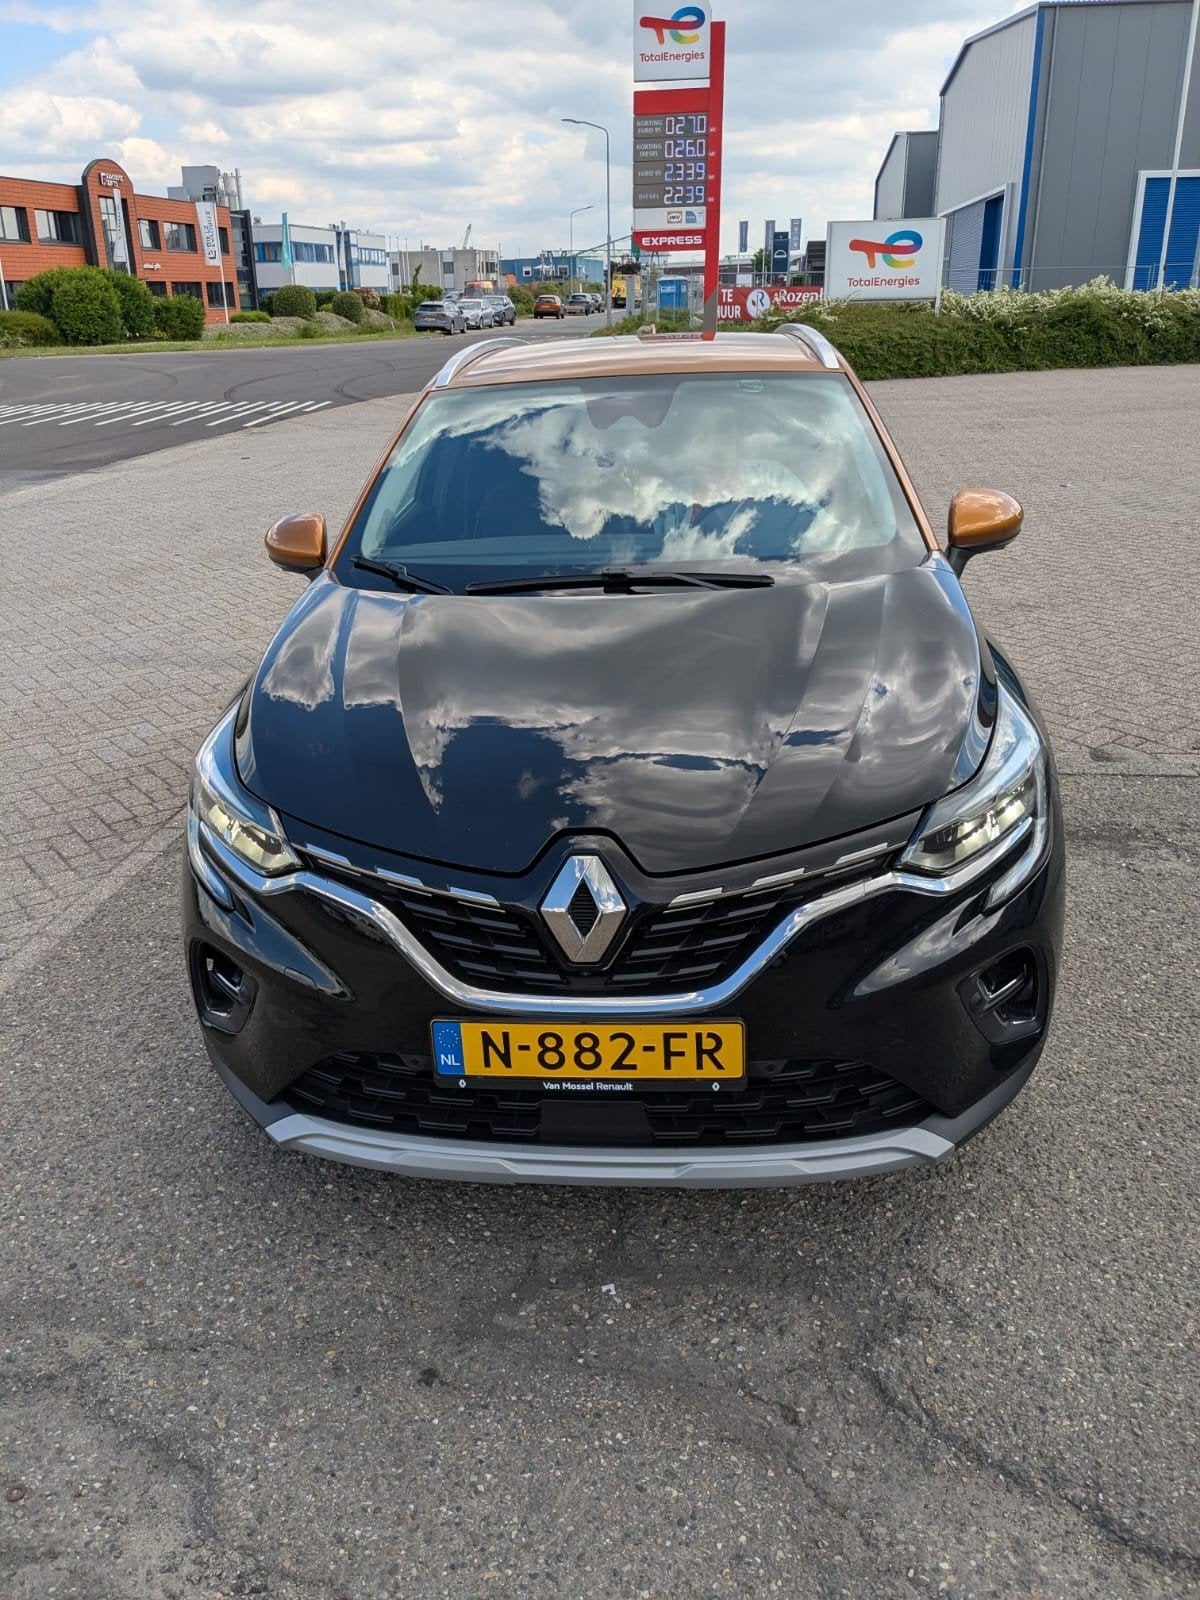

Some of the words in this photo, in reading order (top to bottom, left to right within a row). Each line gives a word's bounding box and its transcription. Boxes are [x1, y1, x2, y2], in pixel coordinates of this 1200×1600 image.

[640, 50, 705, 63] TotalEnergies
[641, 235, 702, 246] EXPRESS
[847, 275, 920, 288] TotalEnergies
[721, 288, 734, 303] TE
[481, 1030, 726, 1071] N-882-FR
[440, 1054, 461, 1066] NL
[543, 1081, 561, 1091] Van
[562, 1081, 594, 1091] Mossel
[596, 1081, 633, 1091] Renault
